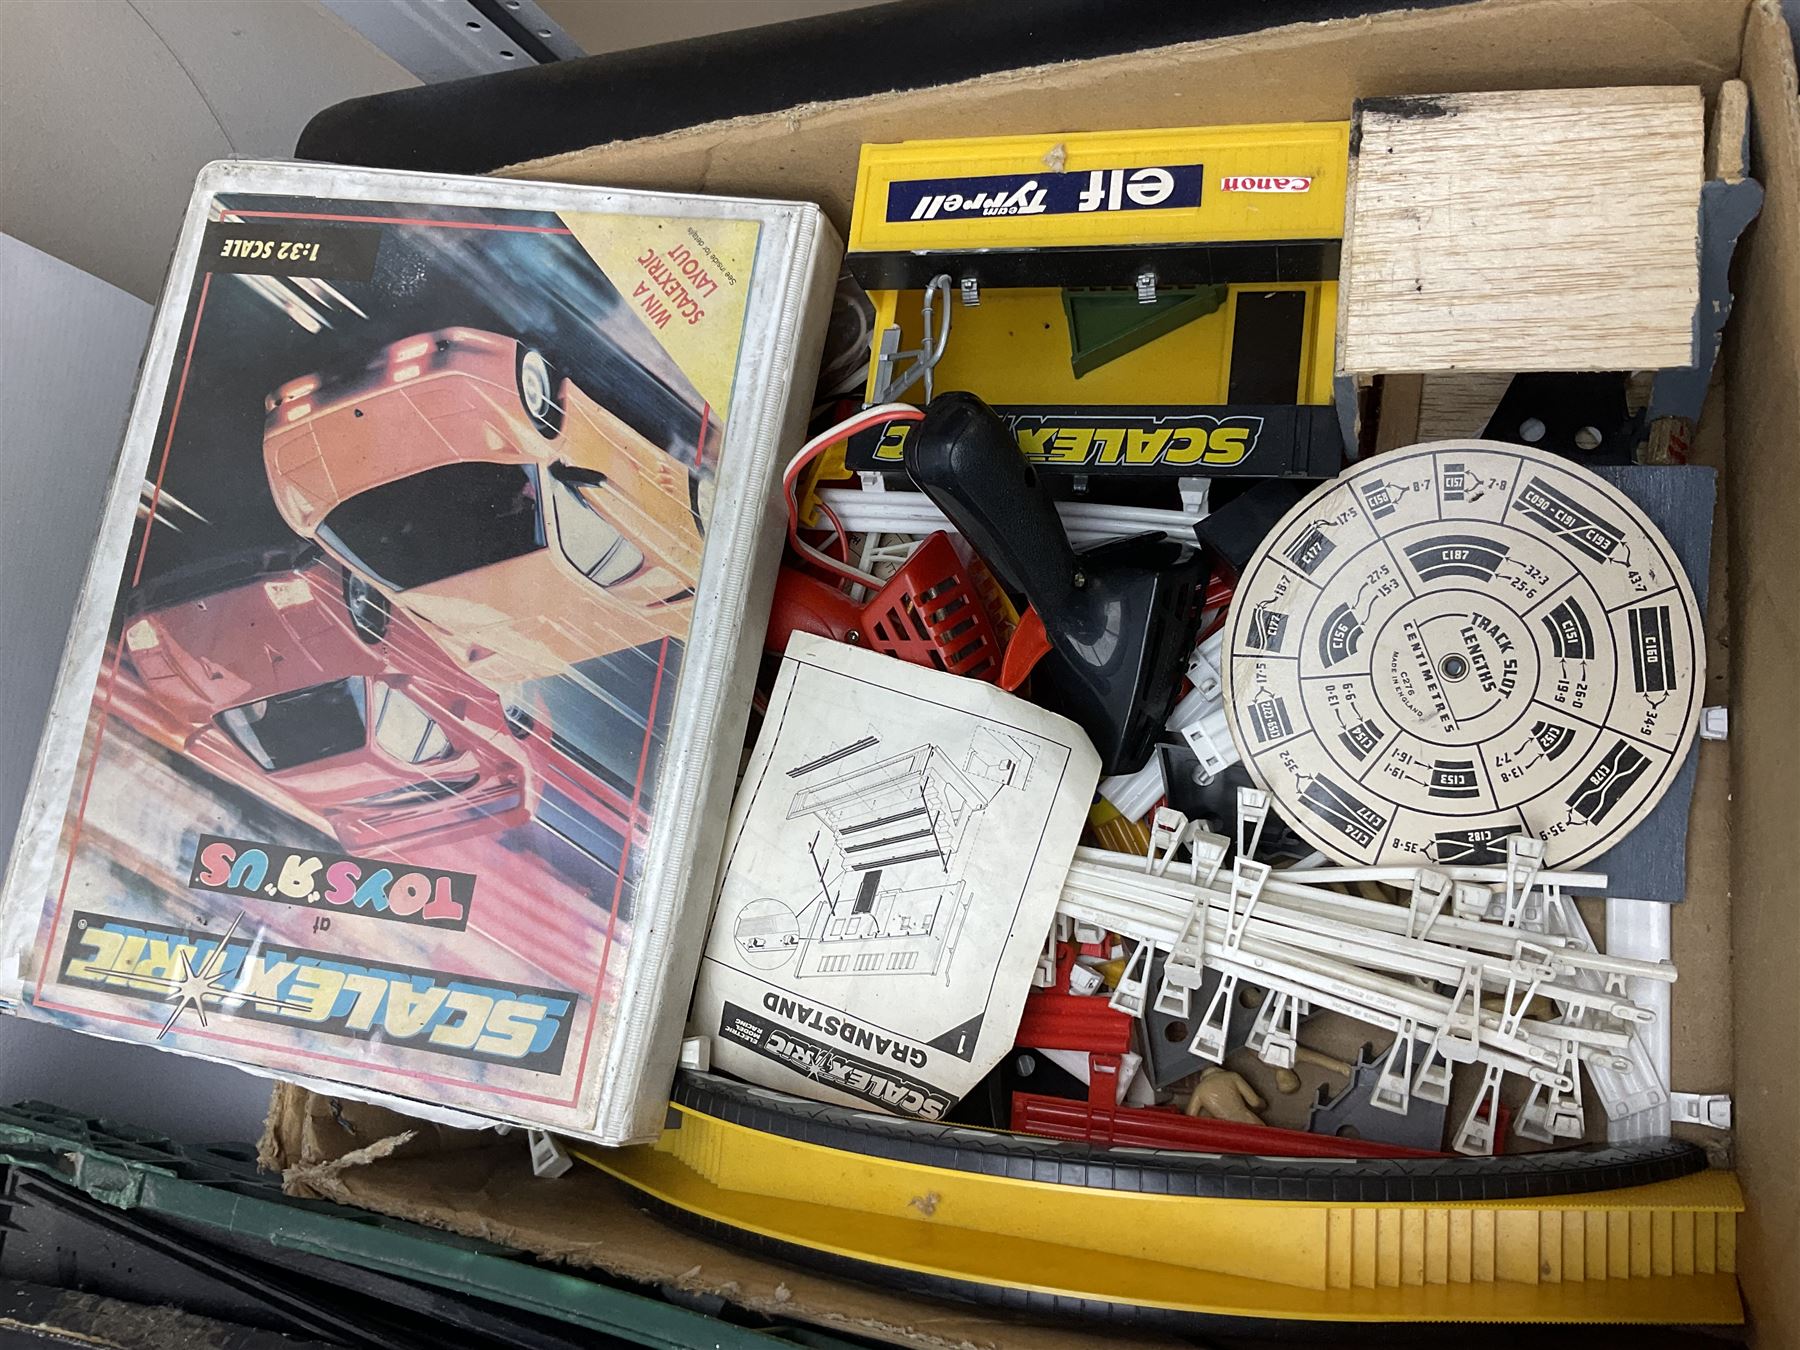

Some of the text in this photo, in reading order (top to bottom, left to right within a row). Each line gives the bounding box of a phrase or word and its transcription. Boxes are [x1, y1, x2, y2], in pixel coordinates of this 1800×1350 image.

[910, 180, 1048, 219] Tyrrell
[1078, 168, 1175, 212] elf
[220, 239, 320, 262] 1:32 SCALE
[687, 226, 737, 286] See inside for details
[667, 244, 718, 298] LAYOUT
[637, 248, 705, 325] SCALEXTRIC
[632, 280, 672, 330] WIN A
[1445, 477, 1464, 489] C157
[1525, 490, 1550, 511] C090
[1554, 508, 1575, 528] C191
[1585, 529, 1612, 549] C193
[1442, 550, 1469, 560] C187
[1332, 623, 1348, 649] C156
[1562, 620, 1578, 644] C151
[1459, 626, 1497, 693] LENGTHS
[1470, 612, 1518, 700] TRACK SLOT
[1644, 636, 1658, 663] C160
[1390, 650, 1423, 717] MADE IN ENGLAND
[1400, 671, 1414, 696] C276
[1402, 622, 1455, 733] CENTIMETRES
[1351, 726, 1372, 750] C154
[1539, 725, 1561, 748] C152
[1440, 774, 1464, 786] C153
[1589, 764, 1610, 785] C178
[1355, 806, 1382, 827] C177
[1345, 824, 1369, 844] C174
[1467, 830, 1491, 842] C182
[199, 842, 269, 889] US
[324, 860, 464, 920] TOYS
[312, 915, 331, 934] at
[724, 1025, 758, 1045] ELECTRIC
[734, 1018, 763, 1034] RACING
[734, 1024, 761, 1040] MODEL
[762, 992, 928, 1069] GRANDSTAND
[956, 1034, 967, 1054] 1
[763, 1030, 948, 1120] SCALEXTRIC
